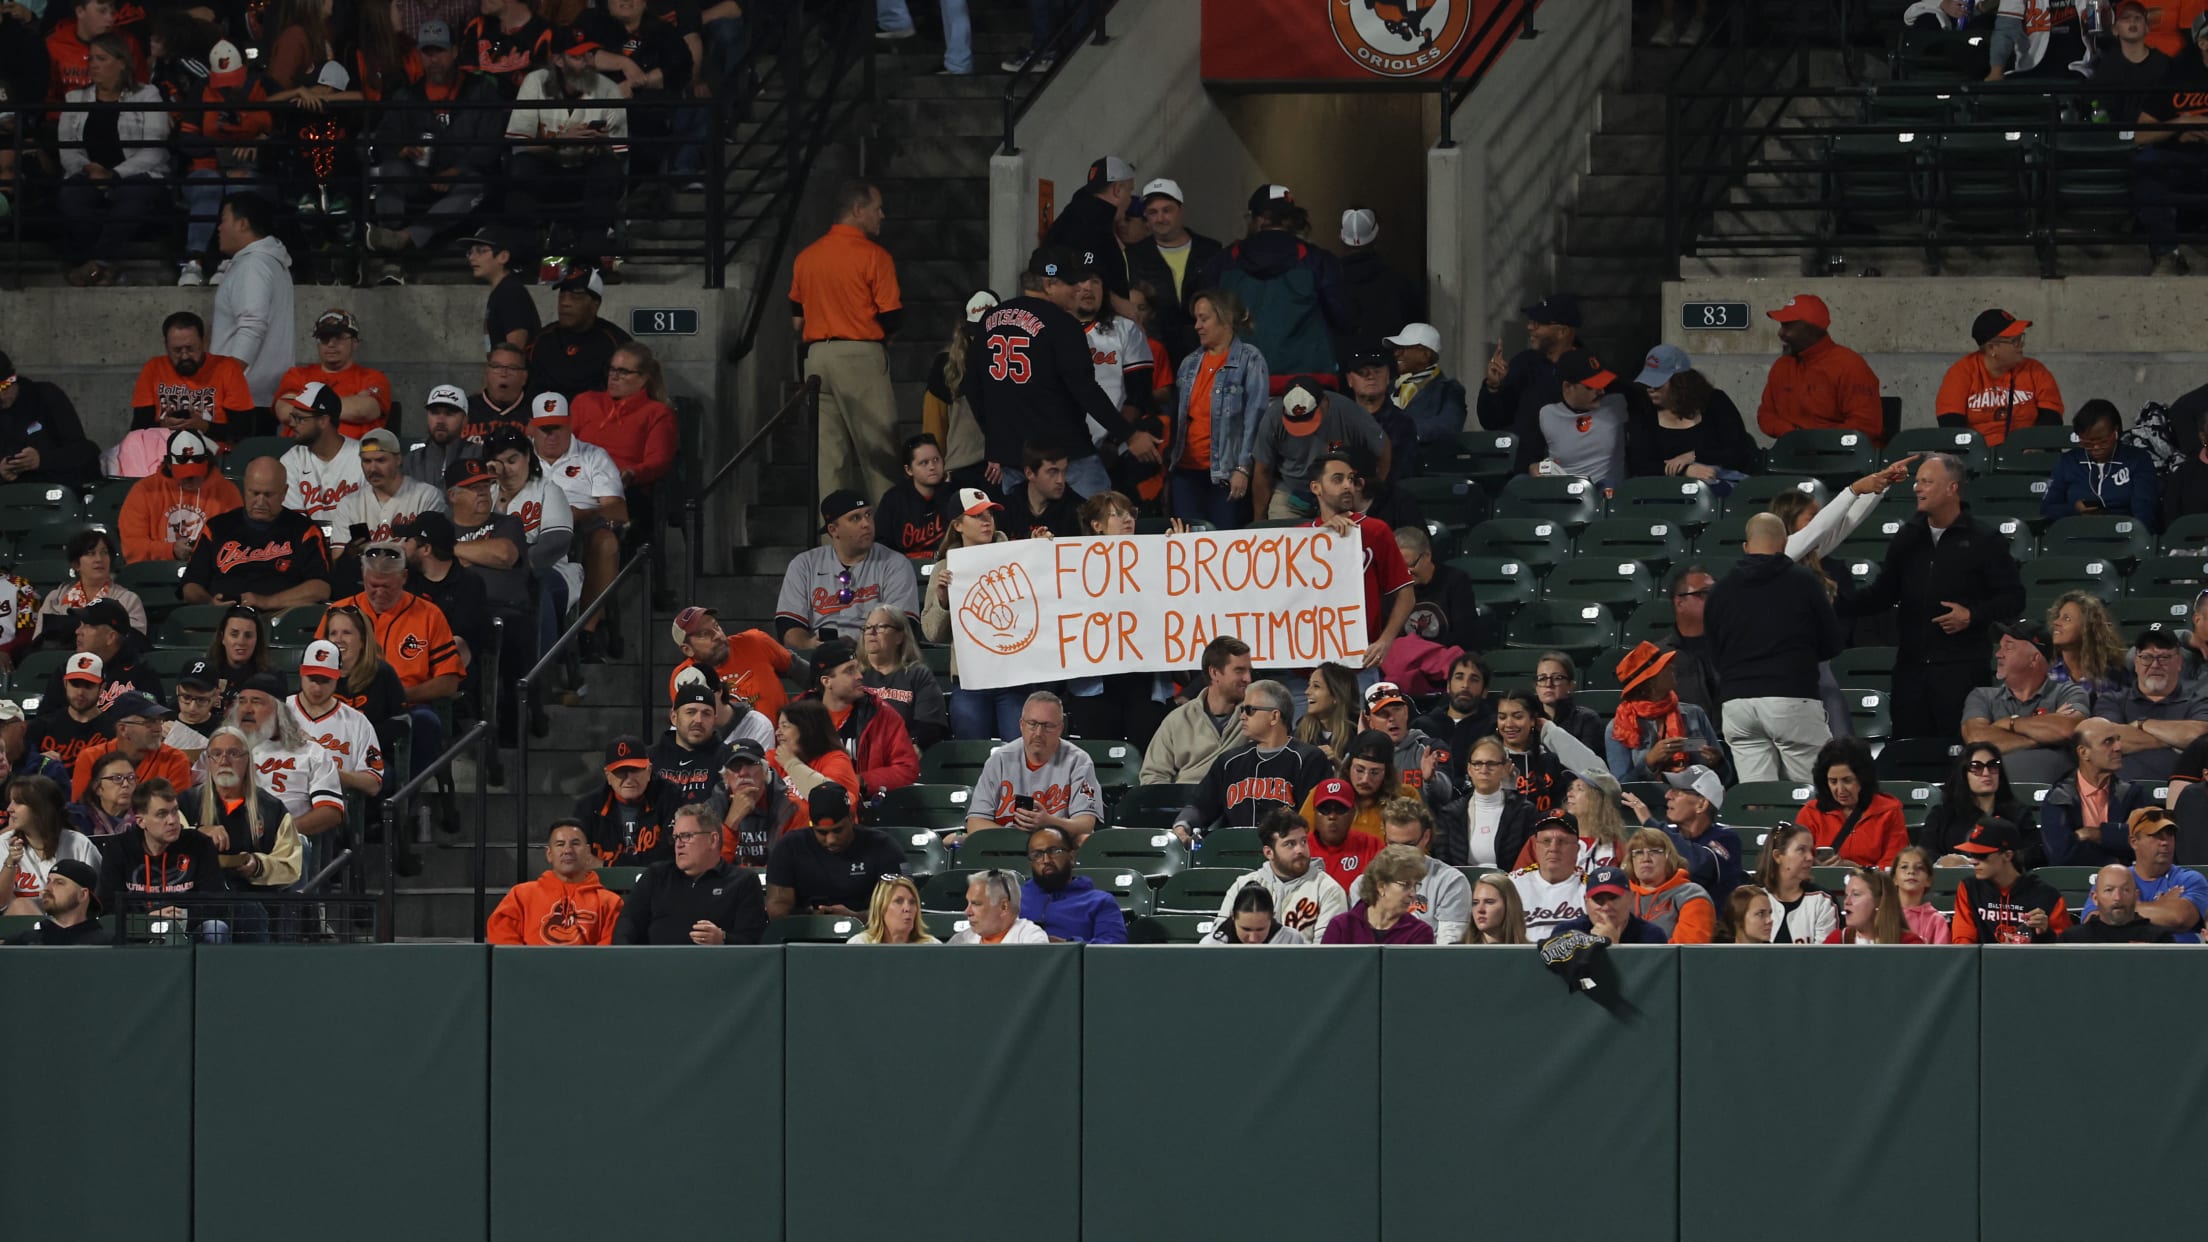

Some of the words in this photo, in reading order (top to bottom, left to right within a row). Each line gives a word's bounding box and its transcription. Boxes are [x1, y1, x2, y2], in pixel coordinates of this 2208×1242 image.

[1358, 47, 1441, 69] ORIOLES
[1083, 251, 1095, 266] B
[653, 311, 676, 331] 81
[1703, 305, 1727, 326] 83
[986, 334, 1033, 384] 35
[2111, 466, 2130, 486] W
[902, 514, 943, 546] Oriol
[216, 540, 293, 573] Orioles
[1055, 540, 1141, 600] FOR
[1165, 532, 1334, 597] BROOKS
[1057, 611, 1144, 669] FOR
[1165, 604, 1367, 663] BALTIMORE
[191, 661, 206, 674] B
[271, 771, 287, 793] 5
[1326, 782, 1341, 794] W
[1226, 777, 1296, 810] ORIOLES
[1340, 855, 1359, 872] W
[1596, 870, 1612, 883] W
